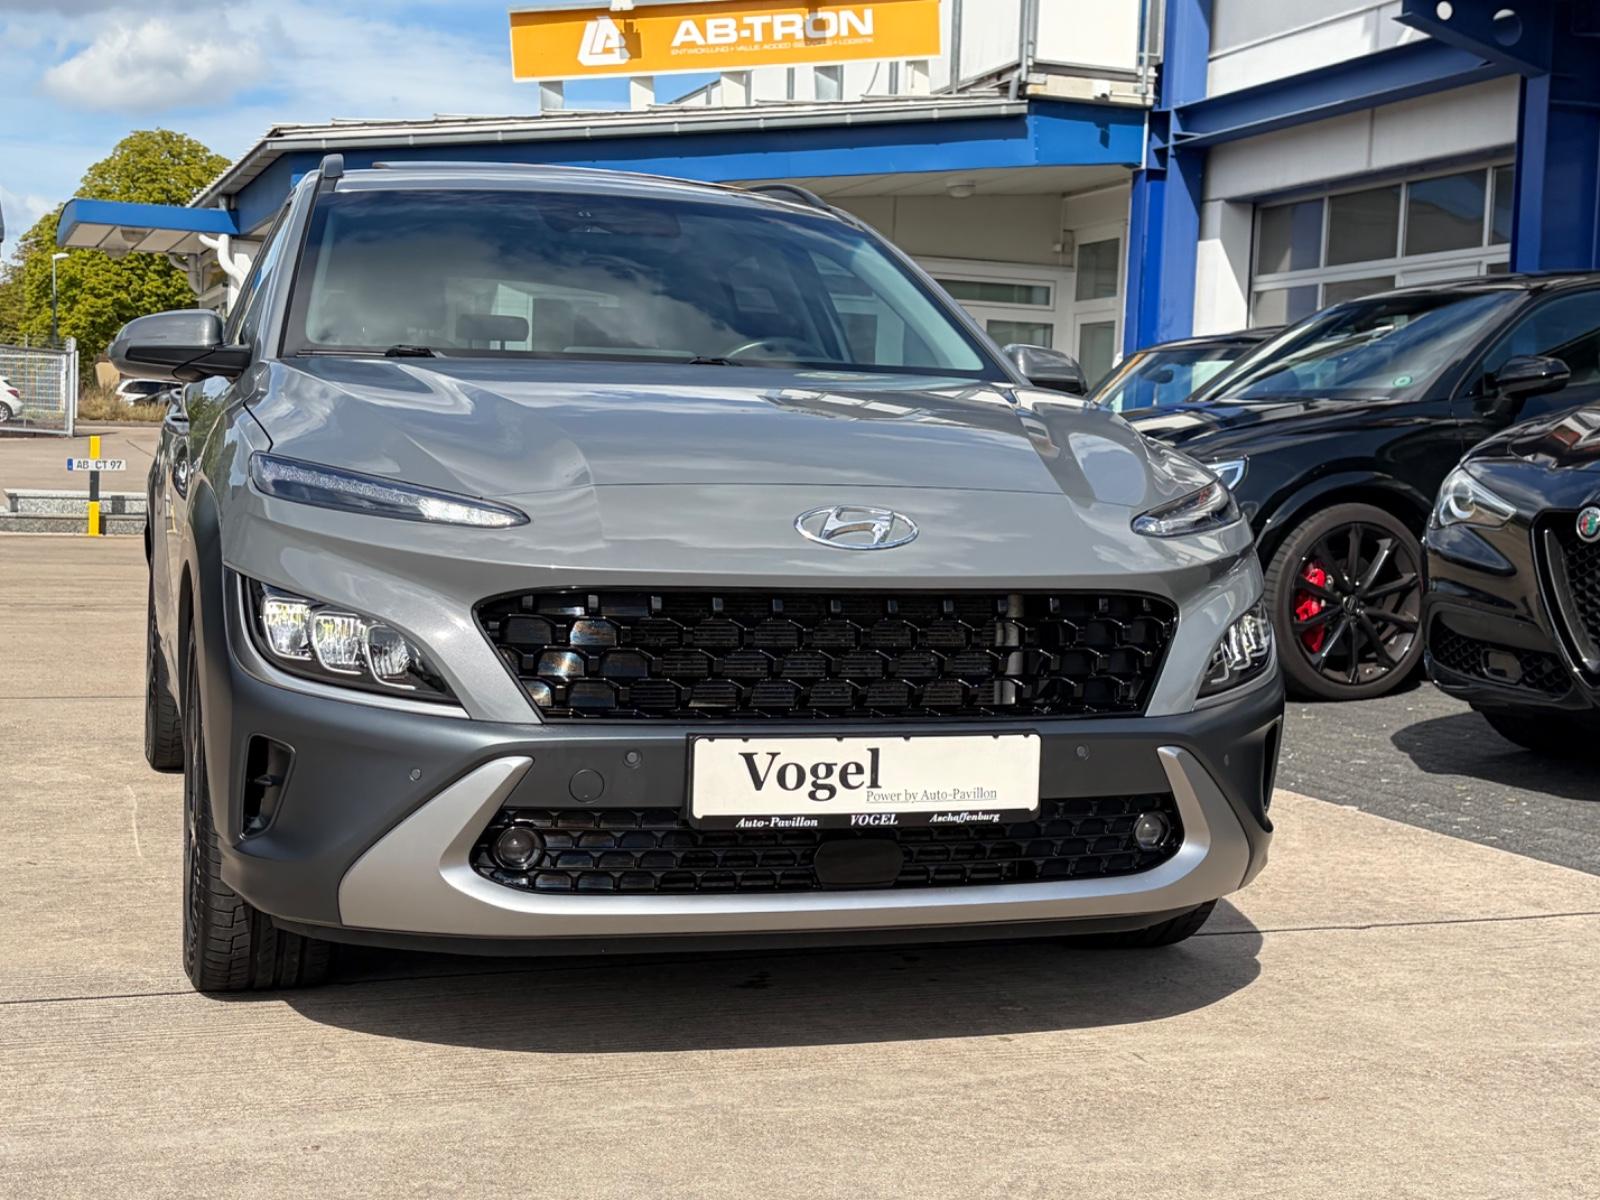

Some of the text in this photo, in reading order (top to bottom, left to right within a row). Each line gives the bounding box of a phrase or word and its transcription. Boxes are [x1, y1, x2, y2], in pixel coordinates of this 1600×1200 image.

[671, 8, 874, 47] AB-TRON
[76, 460, 122, 469] AB CT 97
[738, 747, 882, 802] Vogel
[866, 787, 997, 802] Power by Auto-Pavillon
[736, 811, 1001, 828] Auto-Pavillon VOGEL Aschaffenburg
